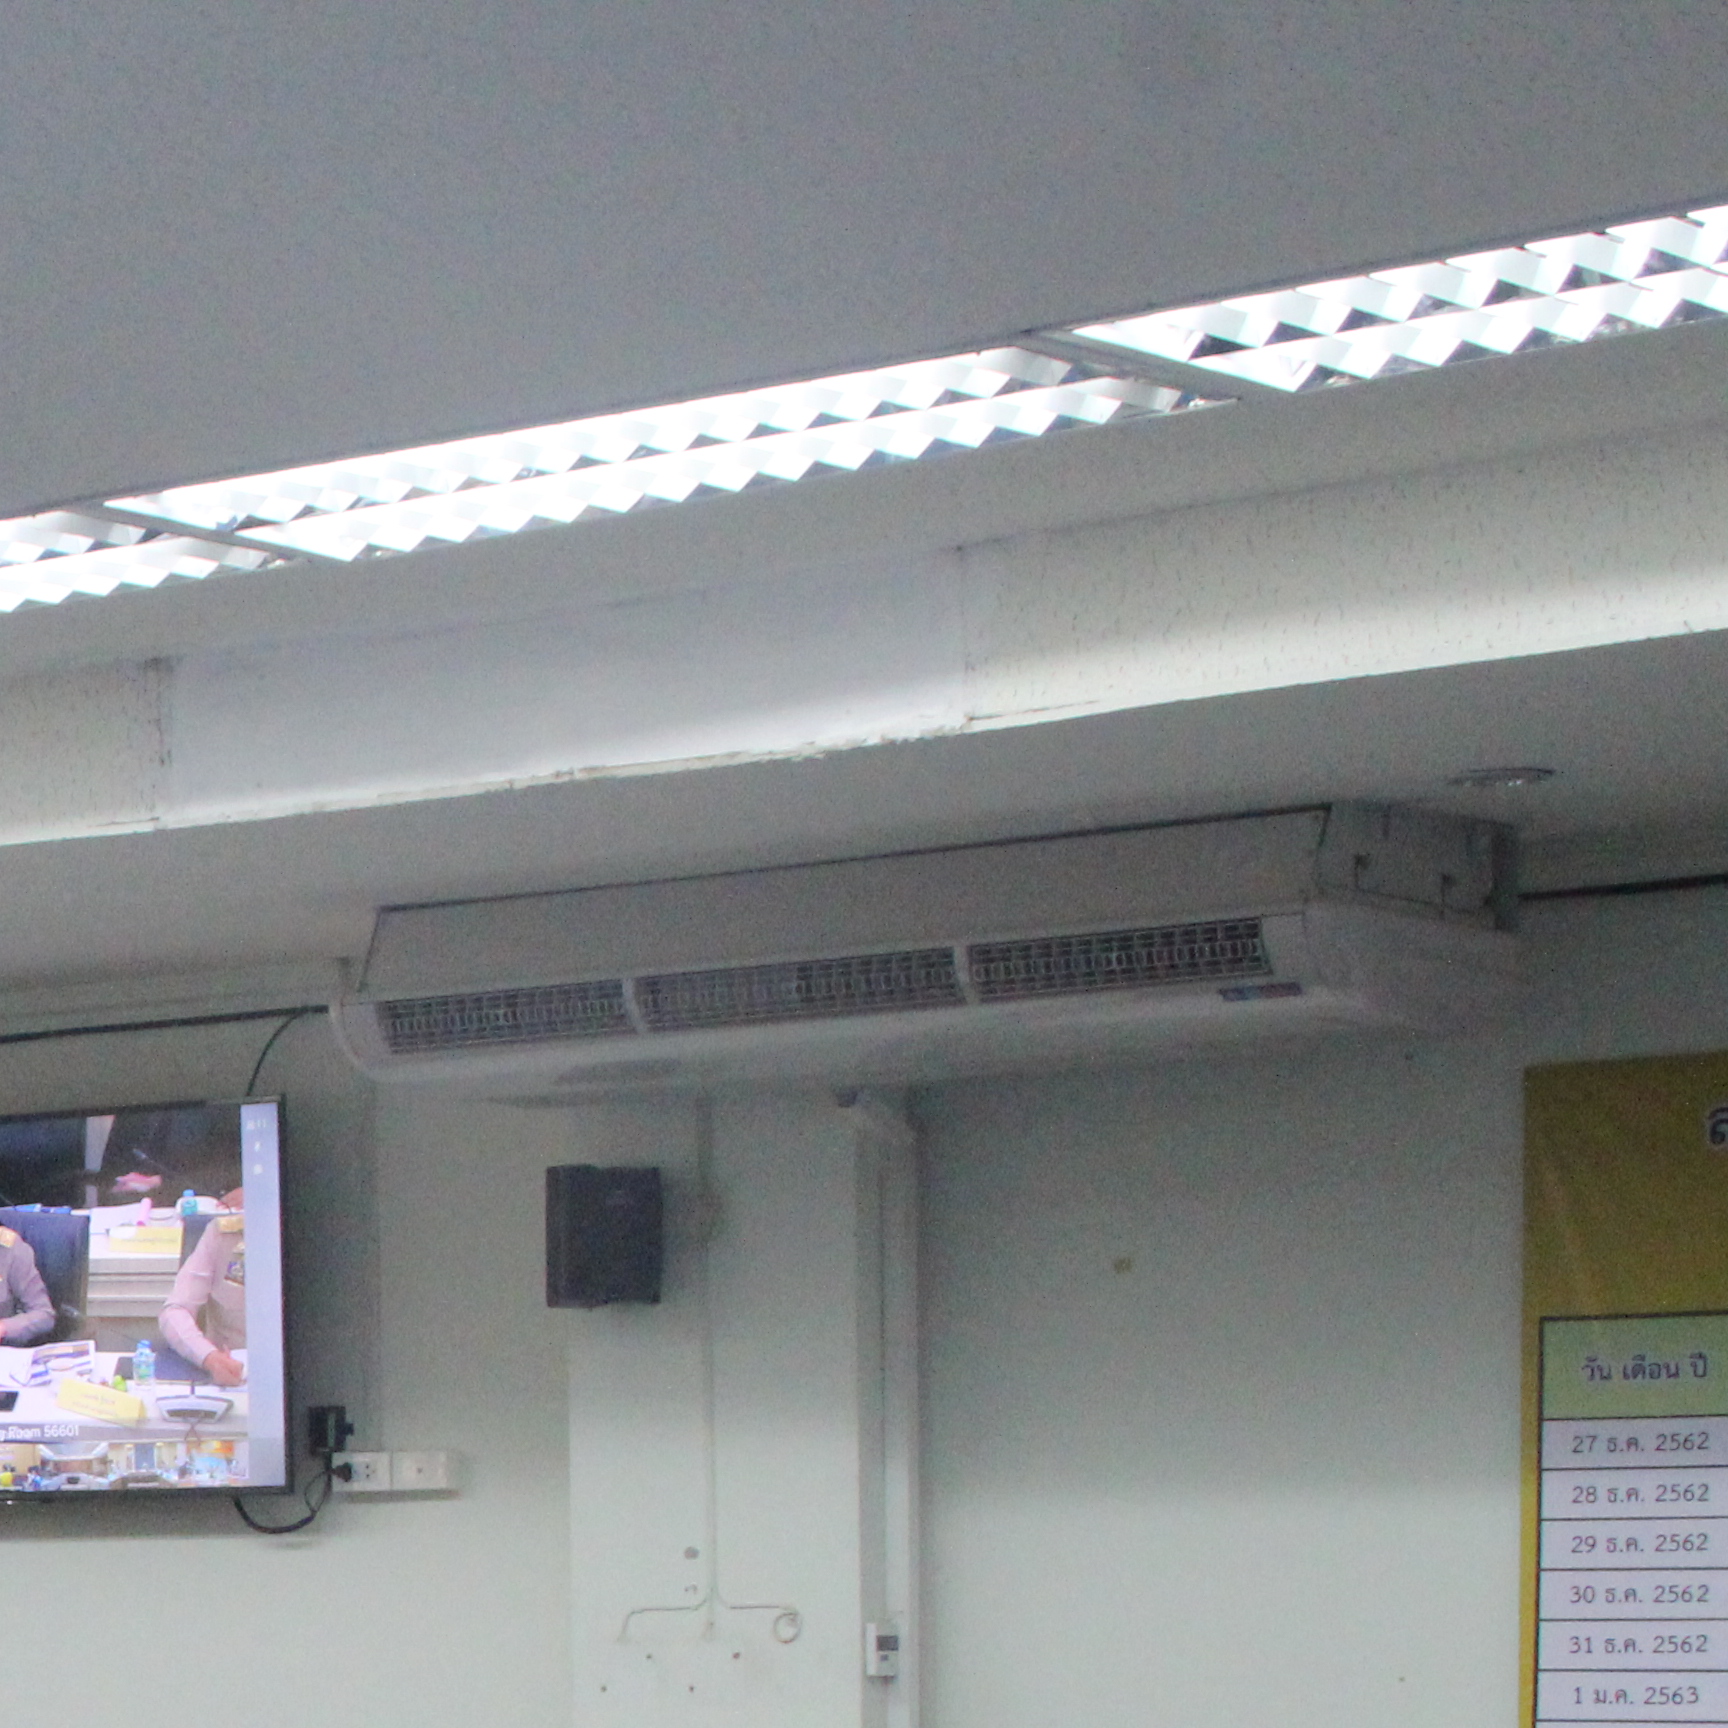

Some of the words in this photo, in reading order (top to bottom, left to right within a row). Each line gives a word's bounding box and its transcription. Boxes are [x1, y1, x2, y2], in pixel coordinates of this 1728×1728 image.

[1581, 1355, 1612, 1381] วัน
[1622, 1353, 1680, 1381] เดือน
[1690, 1352, 1709, 1378] ปี
[1571, 1435, 1597, 1453] 27
[1606, 1436, 1644, 1452] ธ.ค.
[1654, 1431, 1710, 1451] 2562
[1571, 1485, 1597, 1503] 28
[1606, 1486, 1644, 1503] ธ.ค.
[1654, 1483, 1710, 1502] 2562
[1571, 1535, 1596, 1553] 29
[1606, 1536, 1644, 1553] ธ.ค.
[1654, 1533, 1709, 1552] 2562
[1569, 1585, 1595, 1603] 30
[1604, 1586, 1643, 1603] ธ.ค.
[1653, 1584, 1710, 1603] 2562
[1568, 1635, 1594, 1654] 31
[1604, 1636, 1643, 1653] ธ.ค.
[1652, 1634, 1709, 1653] 2562
[1574, 1686, 1583, 1704] 1
[1593, 1688, 1634, 1705] ม.ค.
[1643, 1685, 1700, 1705] 2563
